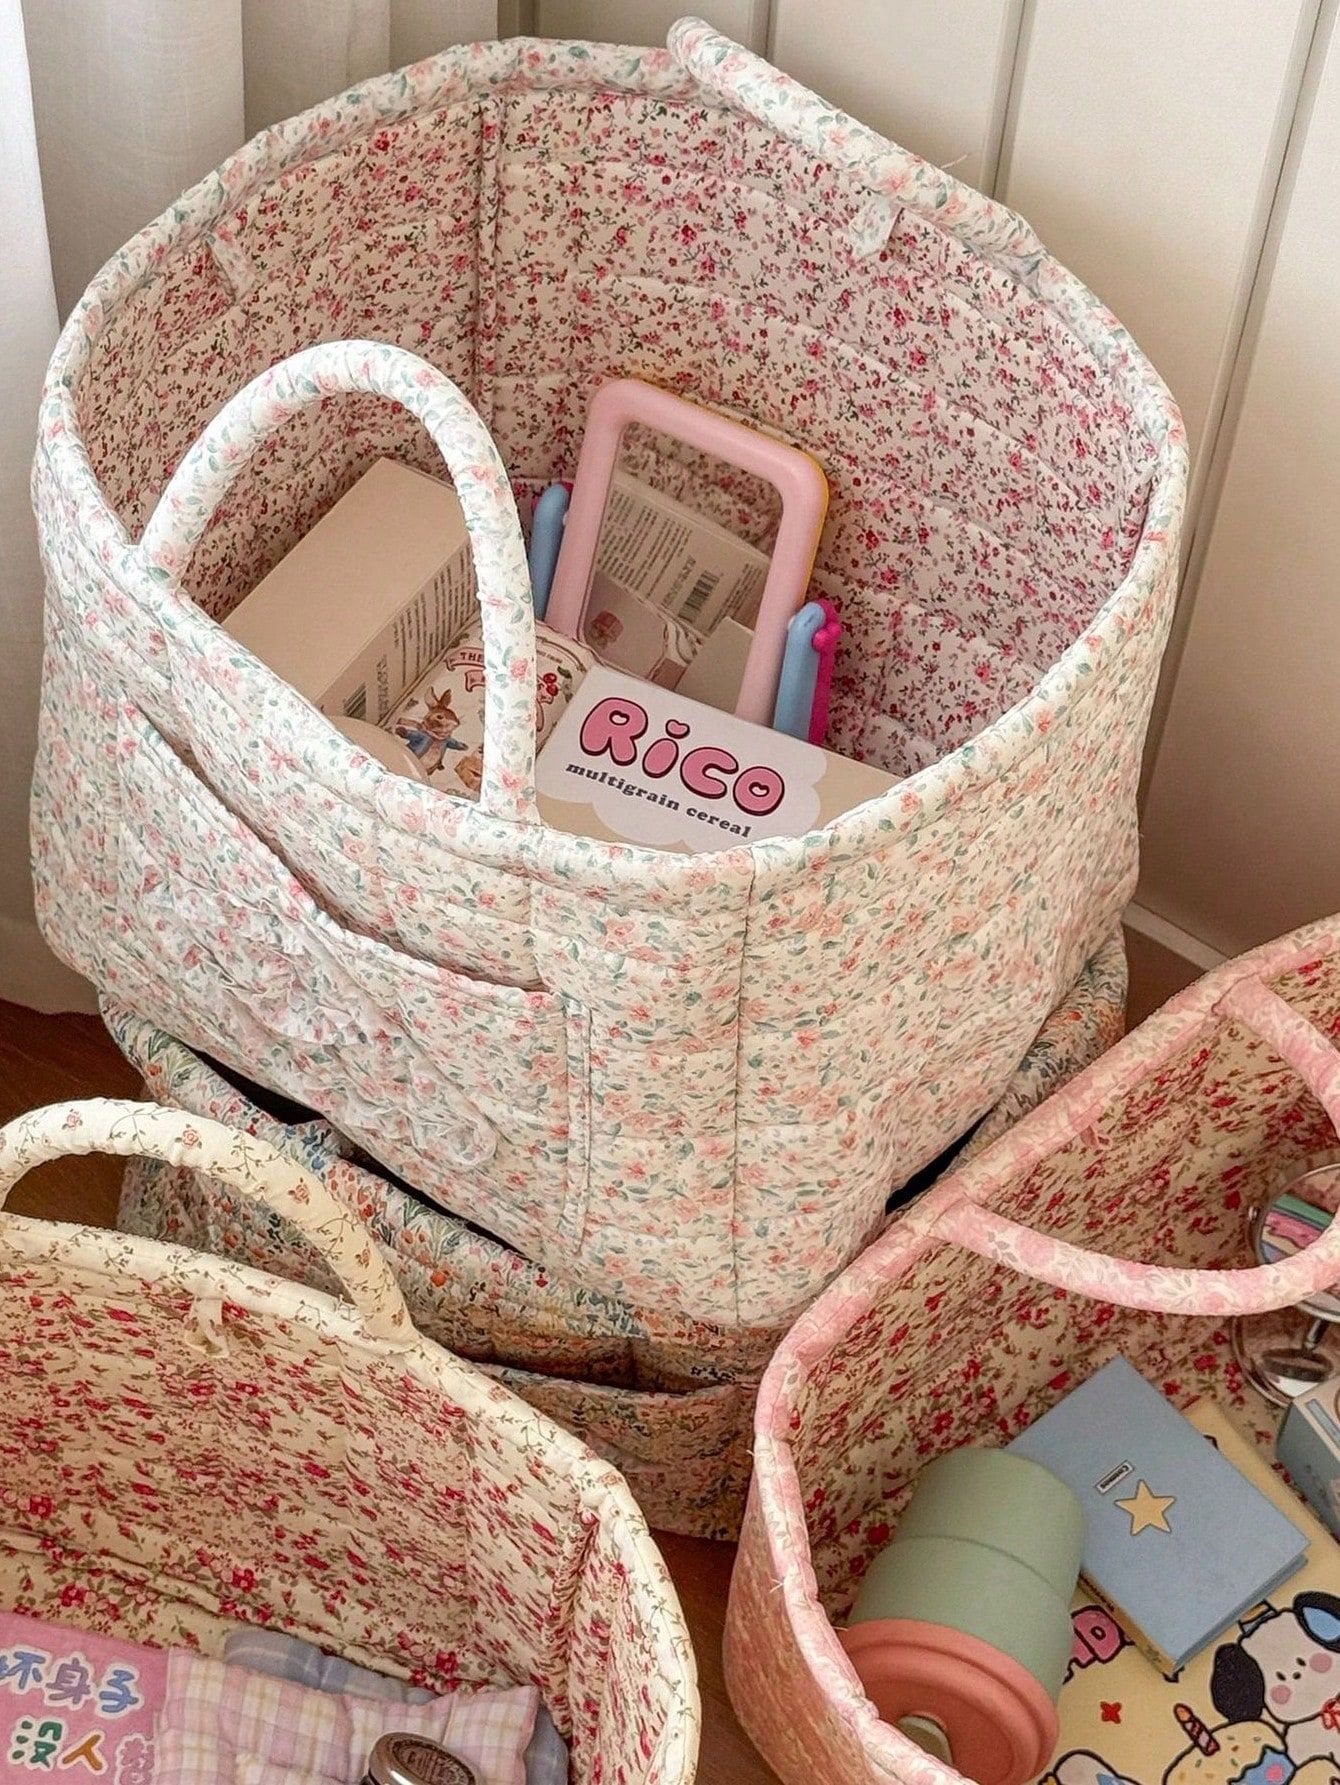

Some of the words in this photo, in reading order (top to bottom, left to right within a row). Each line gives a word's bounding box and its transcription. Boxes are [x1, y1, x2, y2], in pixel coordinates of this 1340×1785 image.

[580, 697, 785, 816] Rico
[565, 763, 680, 811] multigrain
[686, 806, 752, 838] cereal
[0, 1651, 140, 1713] 坏身子
